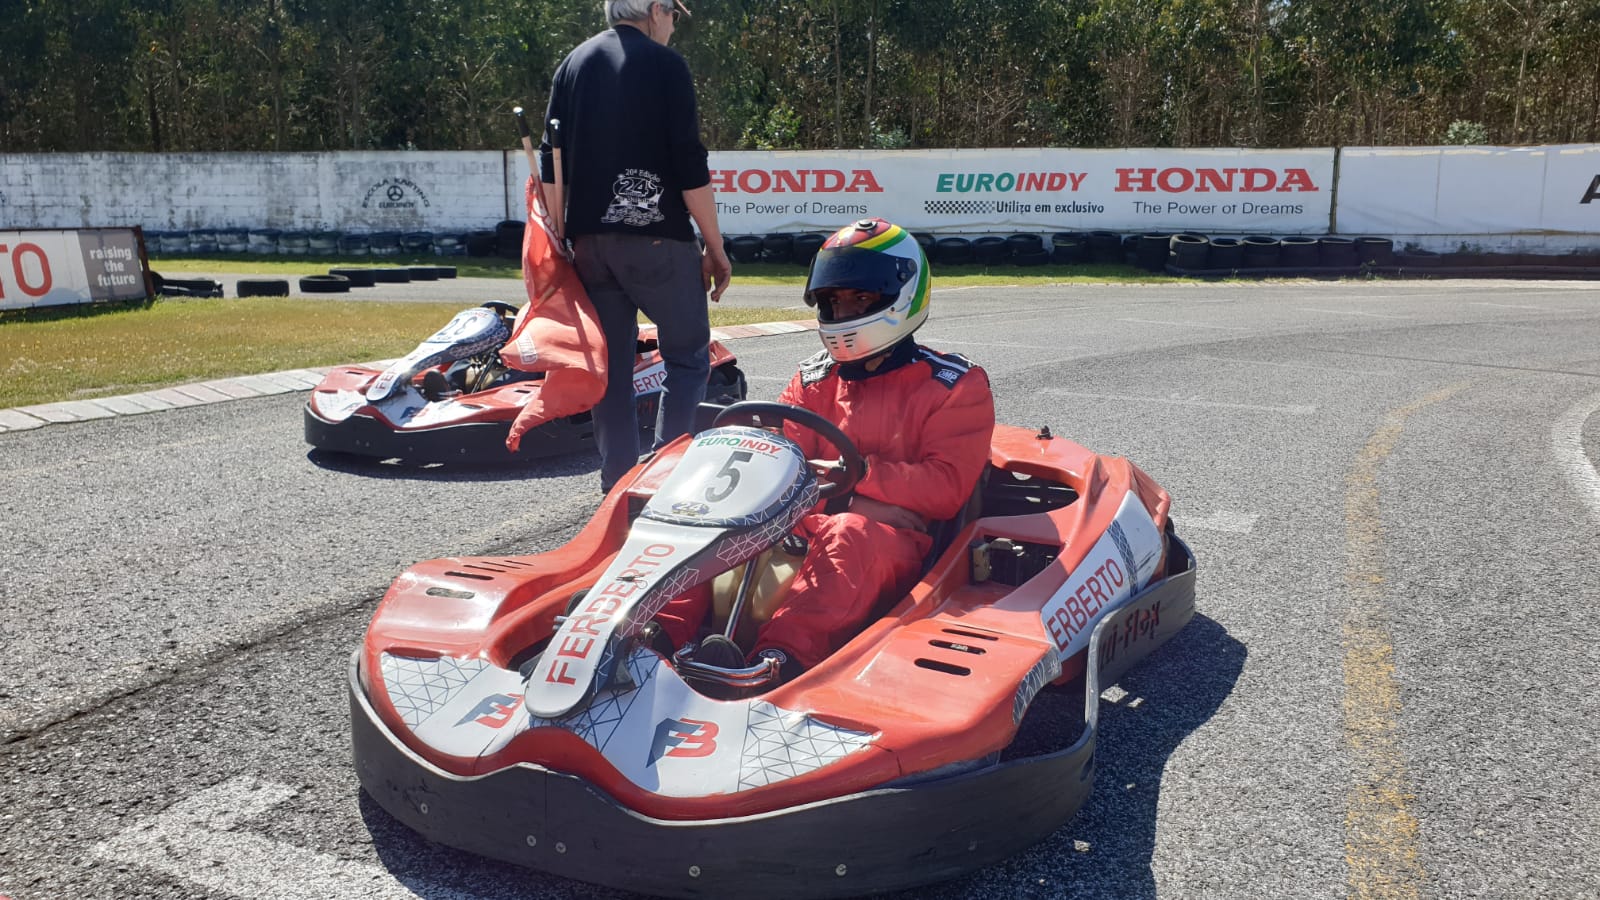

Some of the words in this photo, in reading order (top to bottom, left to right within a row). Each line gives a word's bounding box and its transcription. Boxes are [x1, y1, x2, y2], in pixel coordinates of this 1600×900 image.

[711, 168, 884, 194] HONDA
[936, 172, 1088, 193] EUROINDY
[1114, 167, 1319, 193] HONDA
[715, 202, 741, 214] The
[745, 202, 790, 214] Power
[794, 202, 808, 214] of
[812, 202, 868, 214] Dreams
[1034, 202, 1051, 214] em
[1054, 200, 1105, 214] exclusivo
[1133, 201, 1162, 214] The
[1167, 201, 1217, 215] Power
[1221, 201, 1238, 214] of
[1242, 202, 1304, 215] Dreams
[90, 245, 133, 261] raising
[104, 260, 125, 273] the
[97, 274, 136, 287] future
[697, 437, 783, 455] EUROINDY
[705, 450, 753, 504] 5
